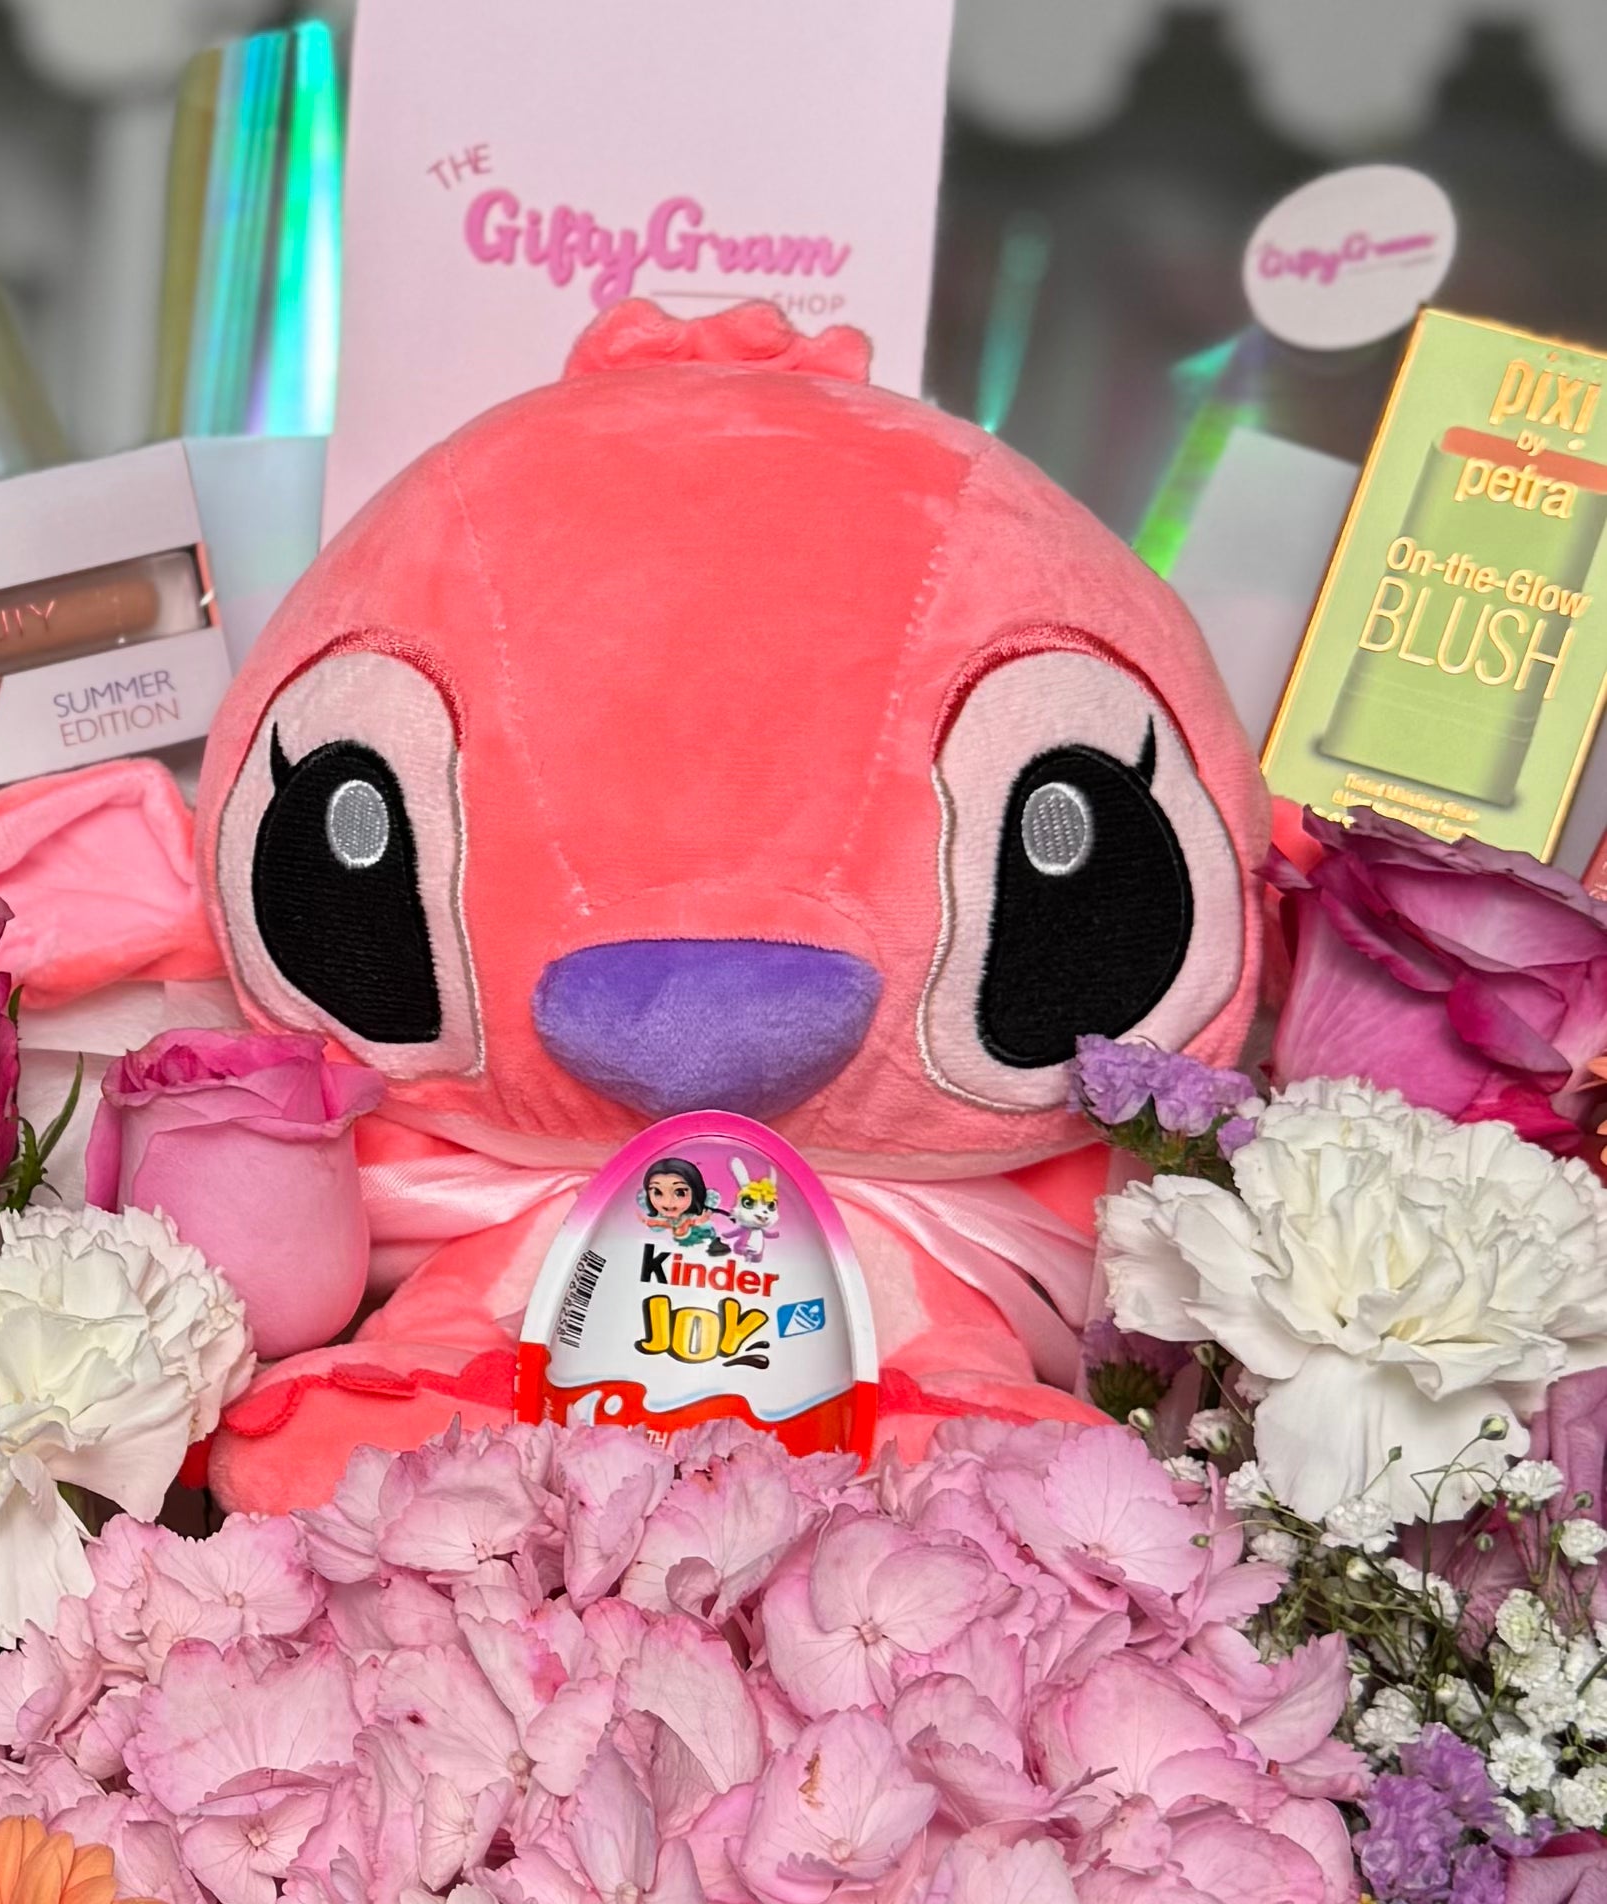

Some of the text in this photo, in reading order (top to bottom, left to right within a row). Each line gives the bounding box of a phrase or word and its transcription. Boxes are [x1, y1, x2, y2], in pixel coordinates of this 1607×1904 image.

[427, 143, 492, 193] THE
[464, 188, 851, 312] GiftyGram
[1489, 353, 1601, 452] pixi
[1516, 429, 1548, 457] by
[1453, 457, 1580, 520] petra
[1386, 536, 1593, 619] On-the-Glow
[1358, 576, 1576, 701] BLUSH
[55, 669, 176, 718] SUMMER
[60, 699, 179, 747] EDITION
[640, 1243, 780, 1297] Kinder
[634, 1294, 770, 1363] JOY
